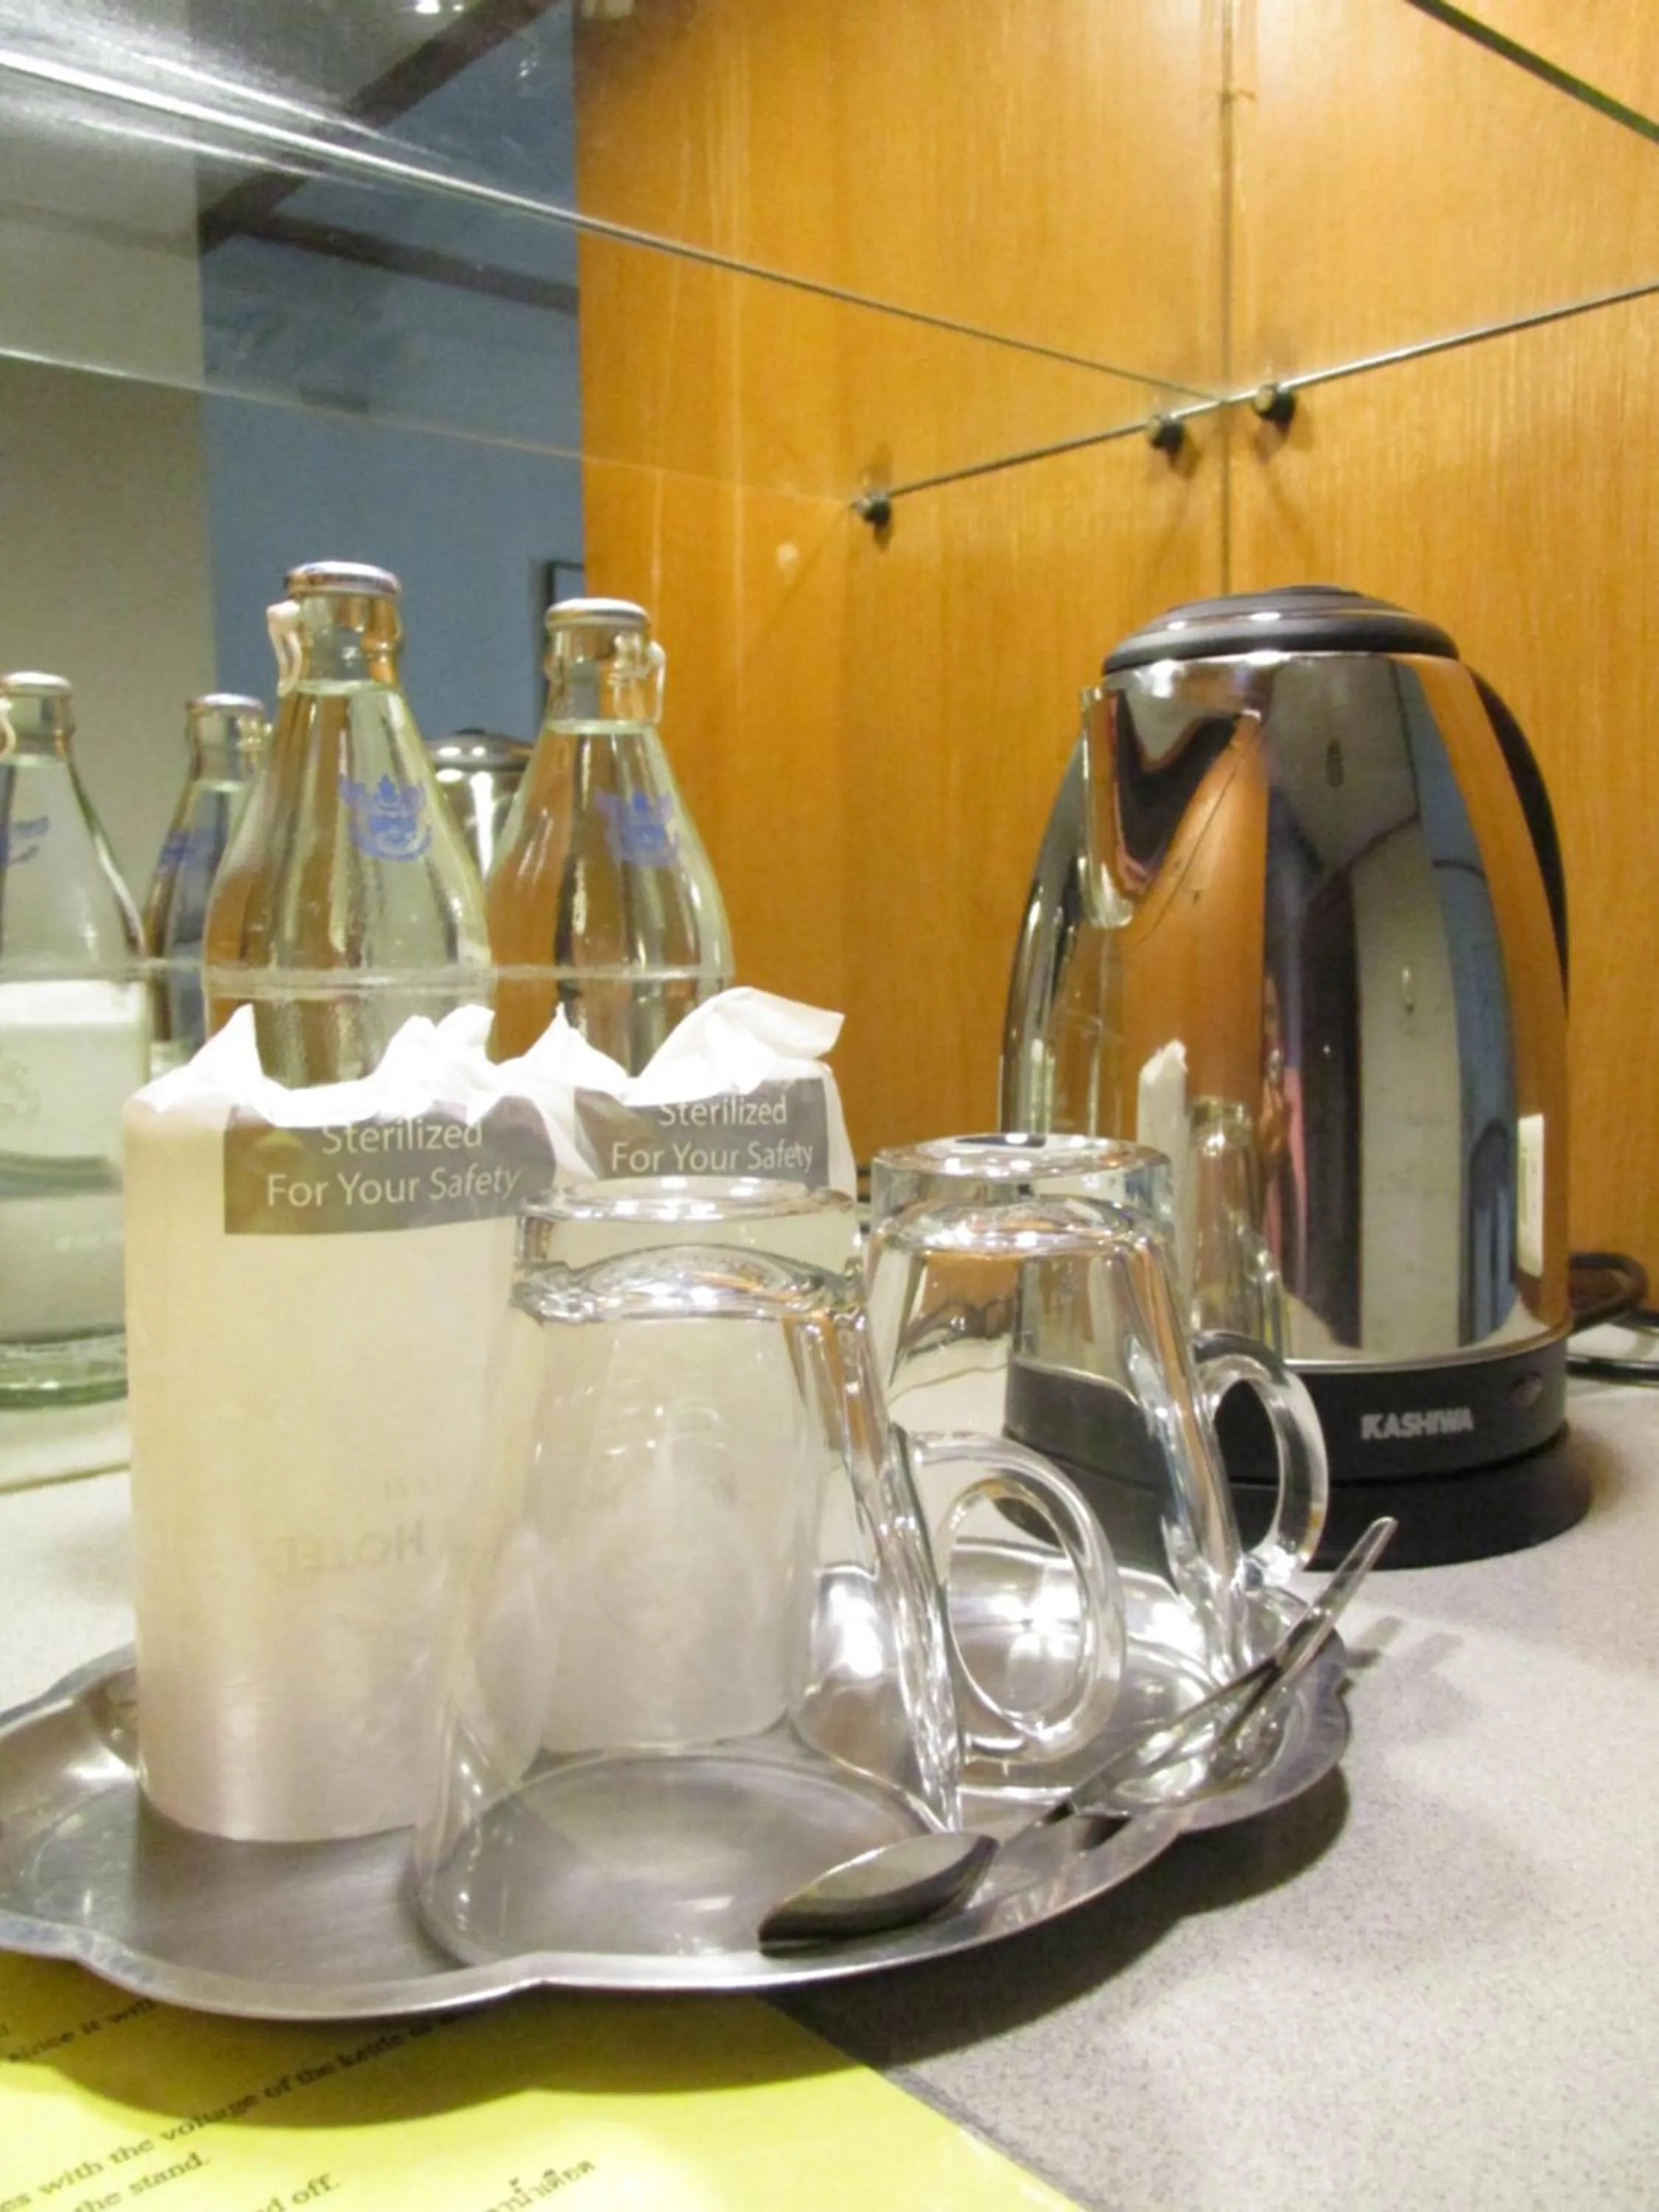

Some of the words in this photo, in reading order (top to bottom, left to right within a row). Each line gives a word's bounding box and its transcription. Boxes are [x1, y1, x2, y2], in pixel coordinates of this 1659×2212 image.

[659, 1096, 787, 1127] Sterilized
[321, 1116, 483, 1155] Sterilized
[611, 1141, 664, 1172] For
[672, 1141, 740, 1172] Your
[747, 1138, 813, 1173] Safety
[267, 1172, 329, 1207] For
[337, 1172, 420, 1206] Your
[429, 1163, 523, 1201] Safety
[1360, 1407, 1474, 1441] KASHIWA
[39, 2161, 103, 2194] with
[108, 2138, 153, 2165] the
[159, 2094, 259, 2140] voltage
[263, 2073, 292, 2098] of
[296, 2062, 335, 2086] the
[129, 2150, 211, 2195] stand.
[291, 2173, 341, 2204] off.
